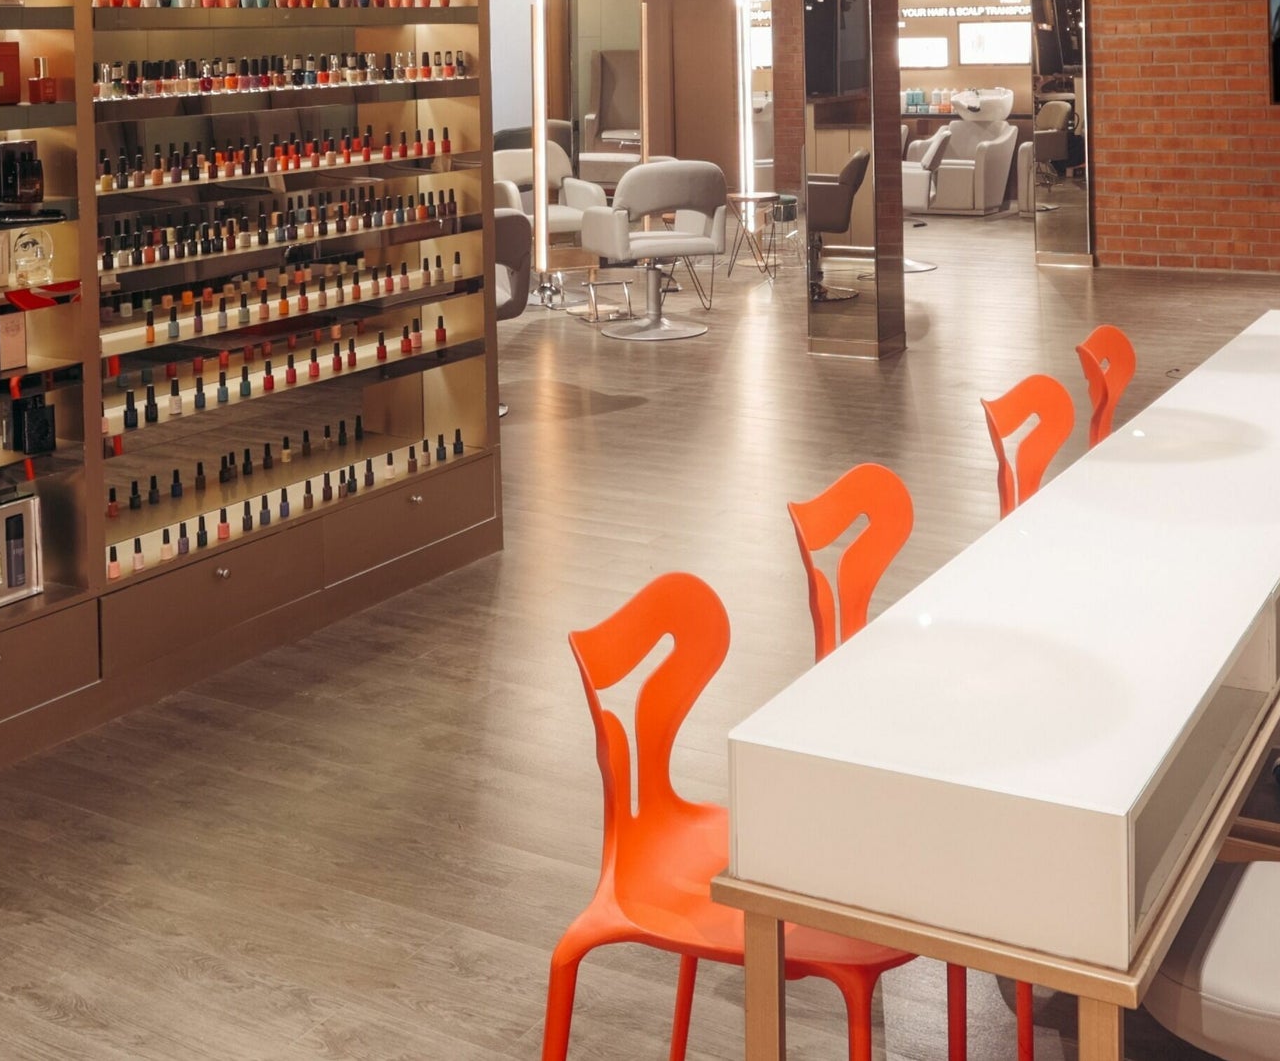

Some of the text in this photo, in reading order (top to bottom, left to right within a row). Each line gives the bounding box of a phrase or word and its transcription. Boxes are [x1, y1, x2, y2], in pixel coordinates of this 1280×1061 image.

[902, 7, 927, 18] YOUR
[927, 7, 949, 17] HAIR
[949, 7, 956, 16] &
[956, 6, 985, 17] SCALP
